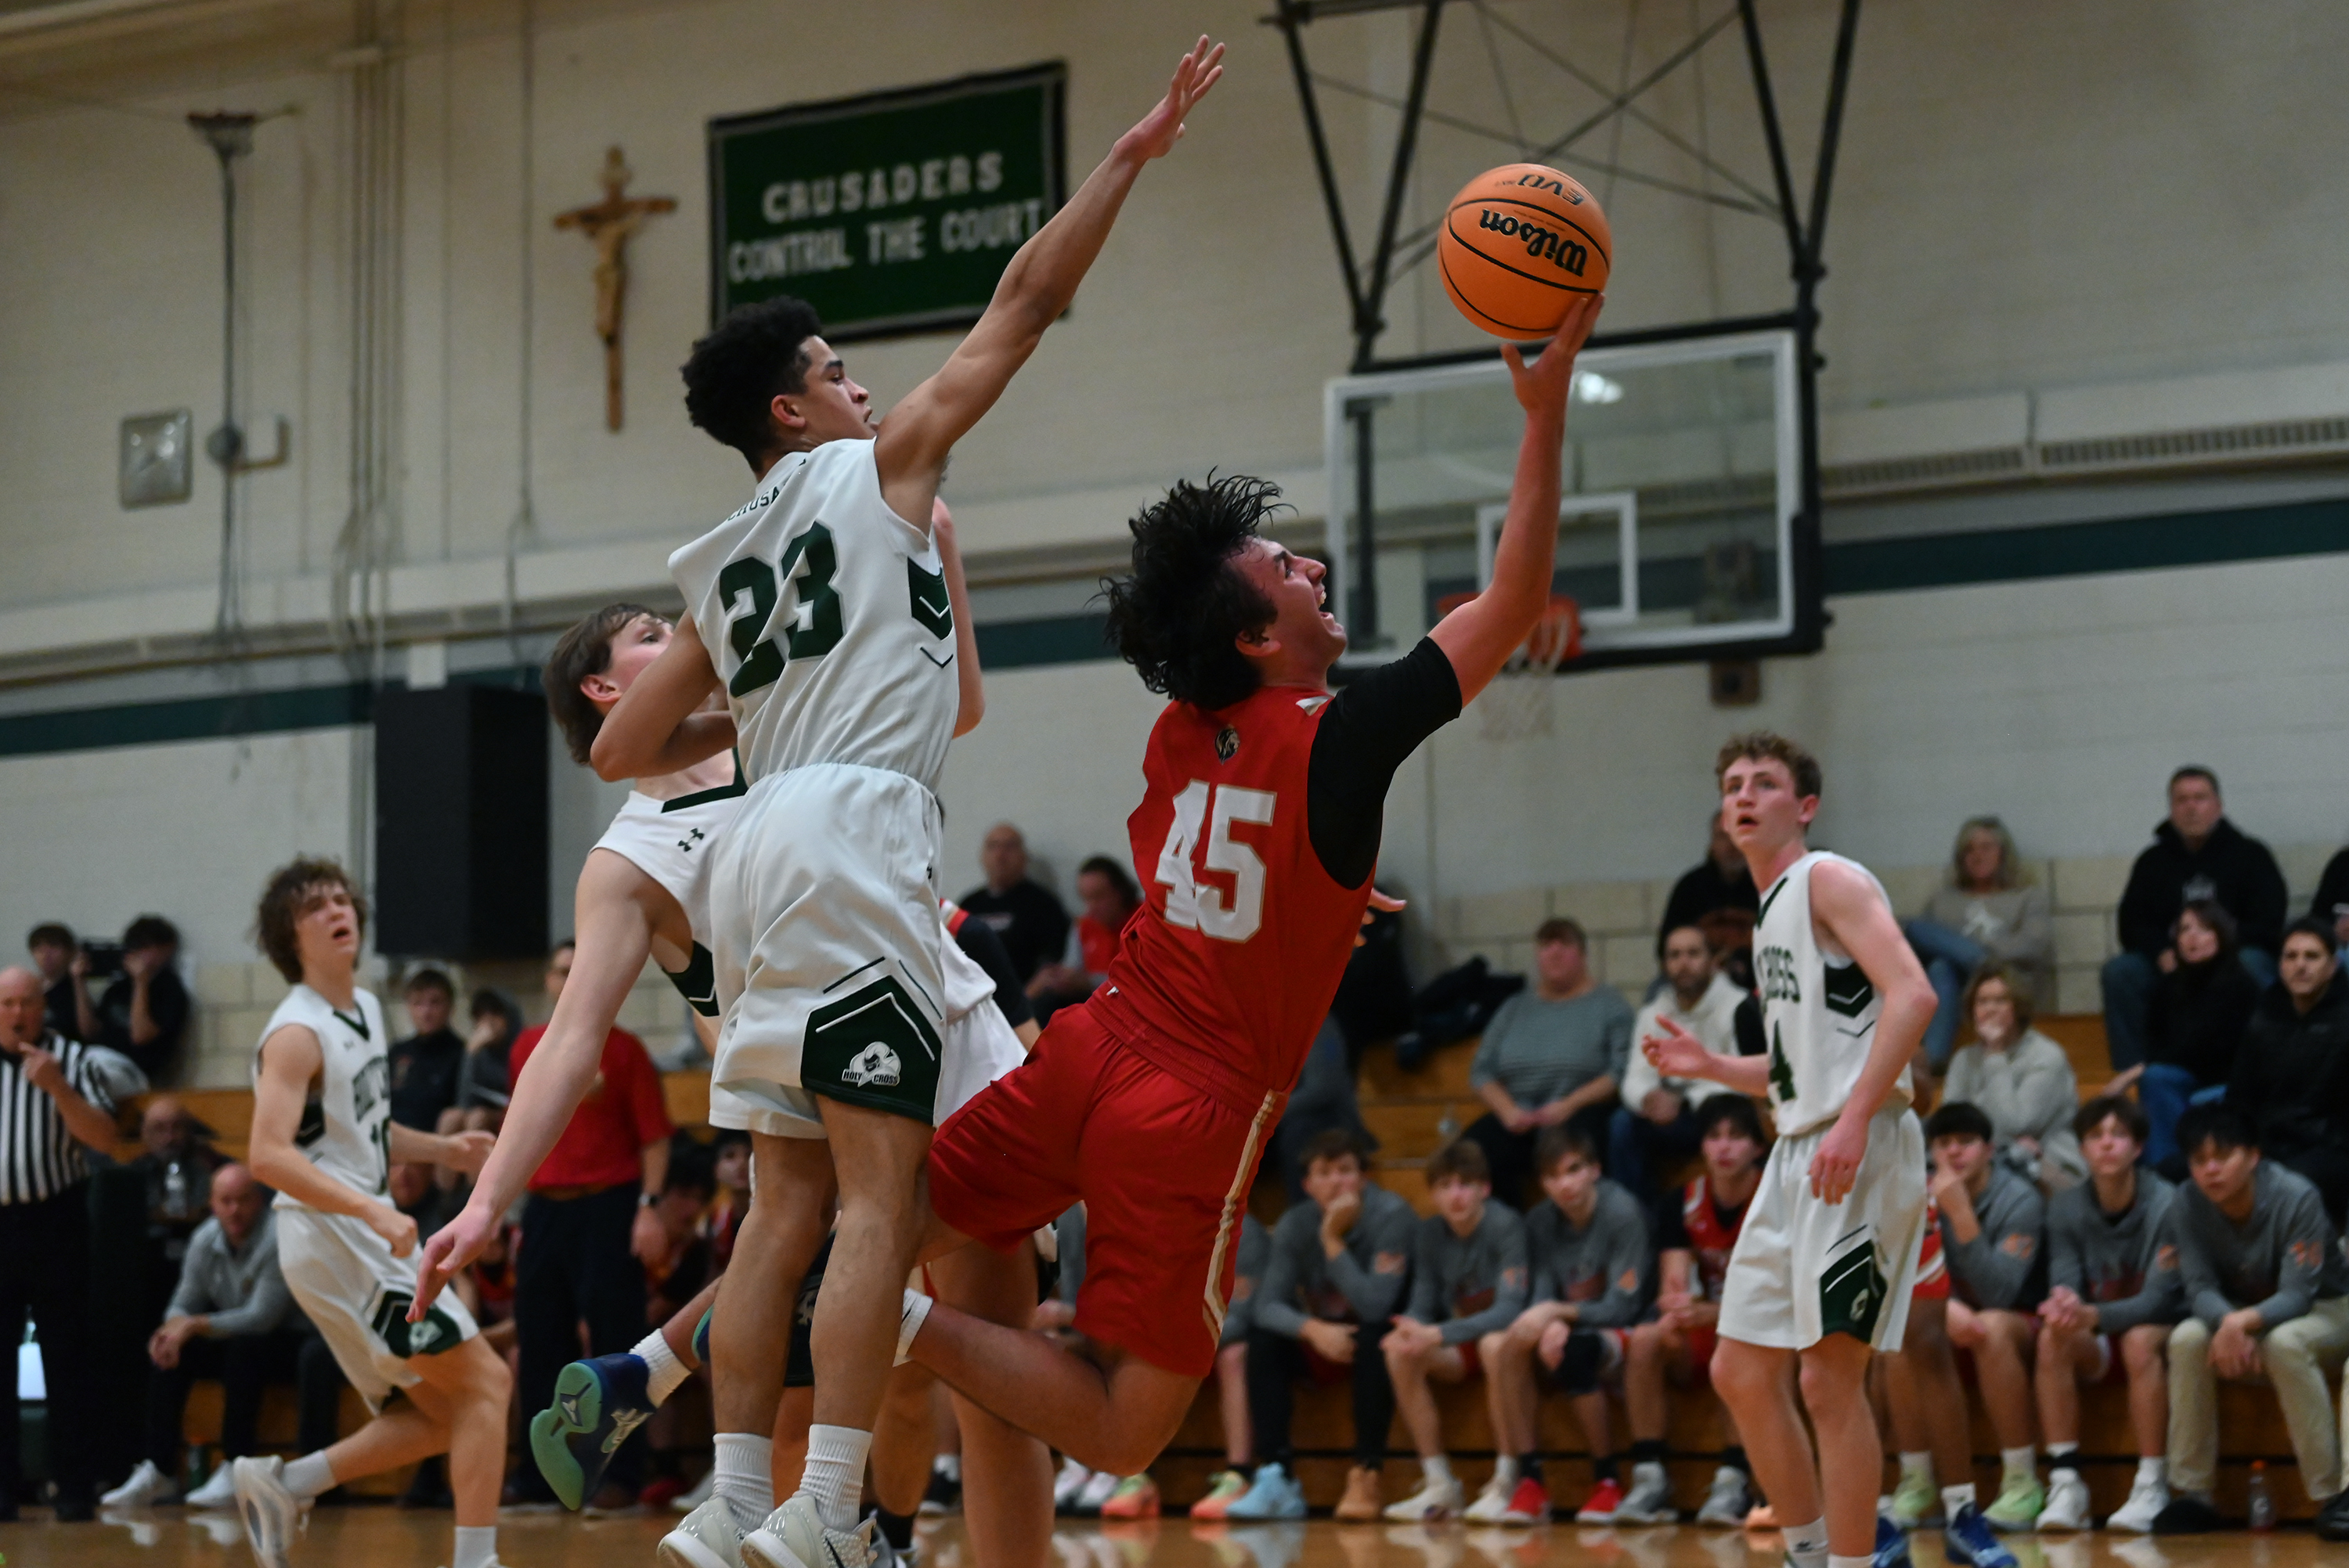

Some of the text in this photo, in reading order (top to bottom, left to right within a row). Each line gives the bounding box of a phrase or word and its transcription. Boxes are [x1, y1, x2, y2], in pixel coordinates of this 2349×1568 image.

[764, 153, 1003, 223] CRUSADERS
[1517, 175, 1585, 206] EVO
[731, 199, 1043, 283] CONTROL THE COURT
[1480, 209, 1587, 277] Wilson
[719, 520, 846, 697] 23
[1154, 778, 1277, 943] 45
[843, 1070, 898, 1084] HOLY CROSS
